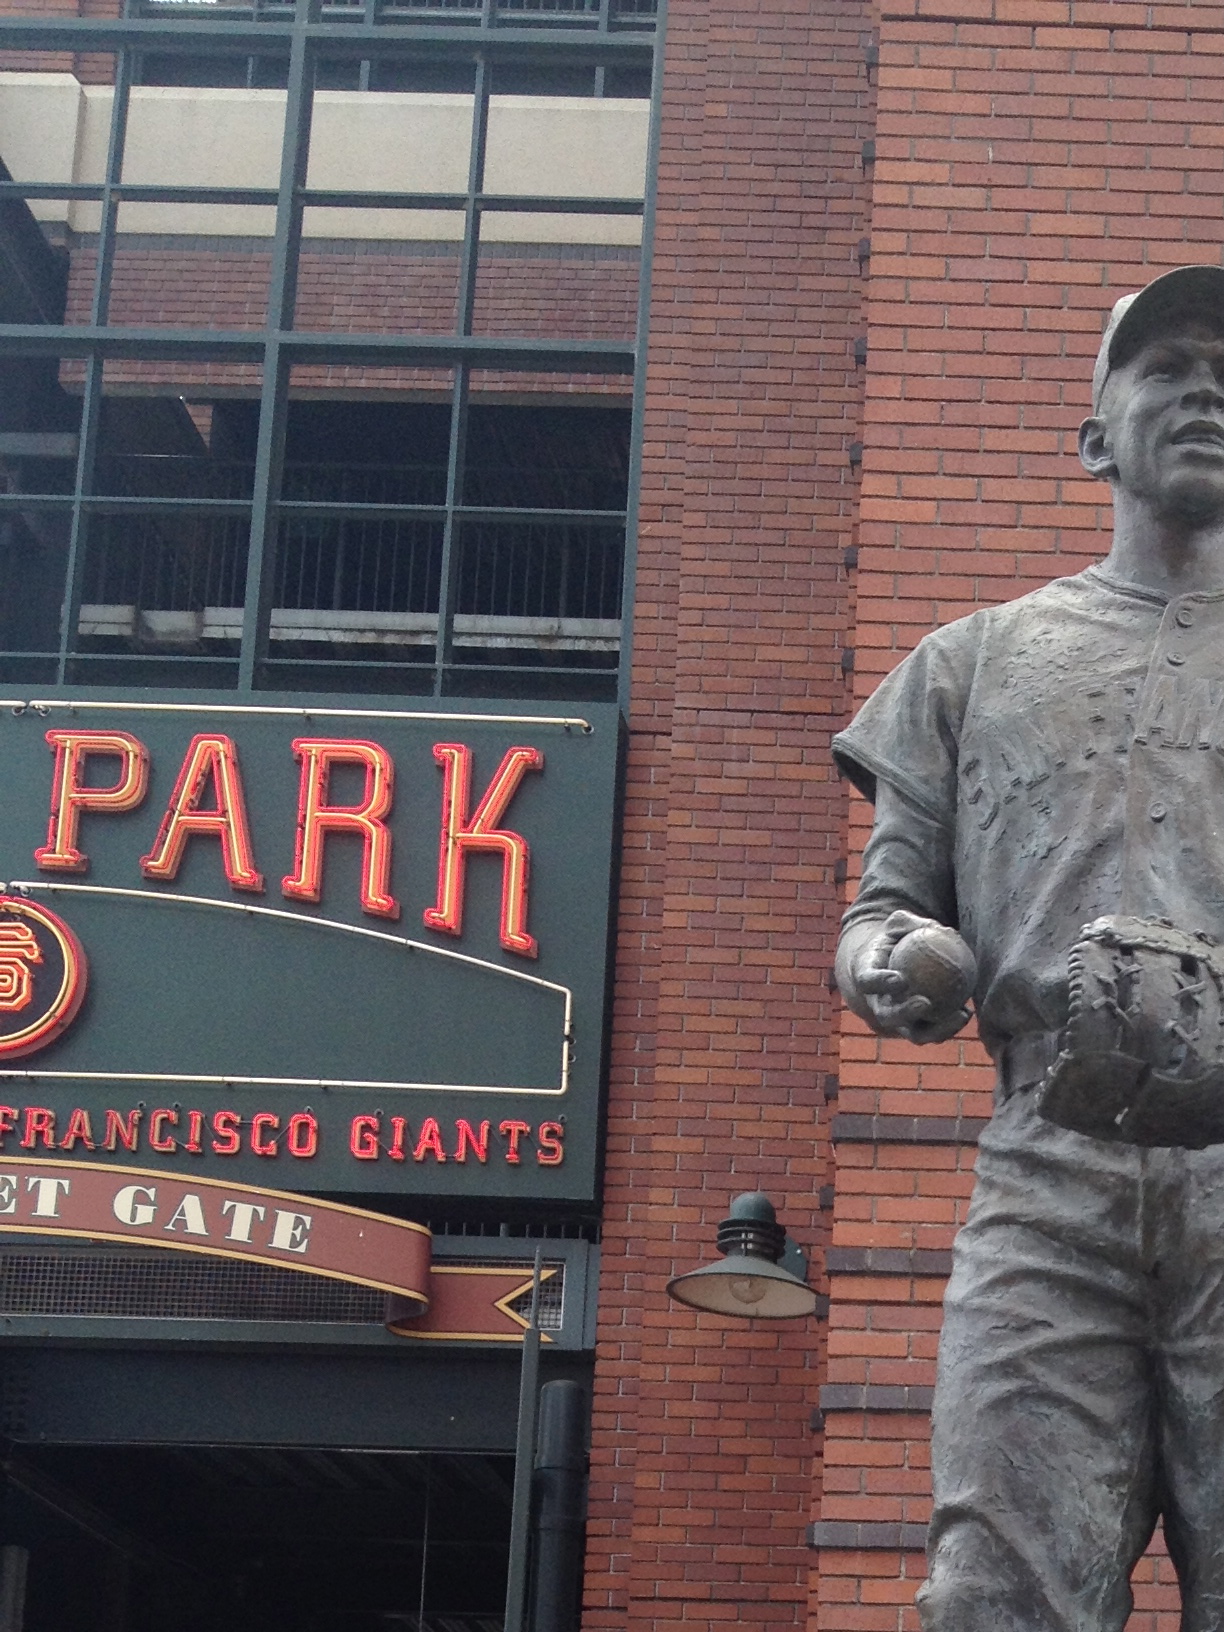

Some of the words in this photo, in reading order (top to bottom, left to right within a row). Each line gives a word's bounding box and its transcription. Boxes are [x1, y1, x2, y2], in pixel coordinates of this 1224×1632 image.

[34, 729, 545, 958] PARK
[350, 1115, 566, 1167] GIANTS
[112, 1184, 313, 1255] GATE
